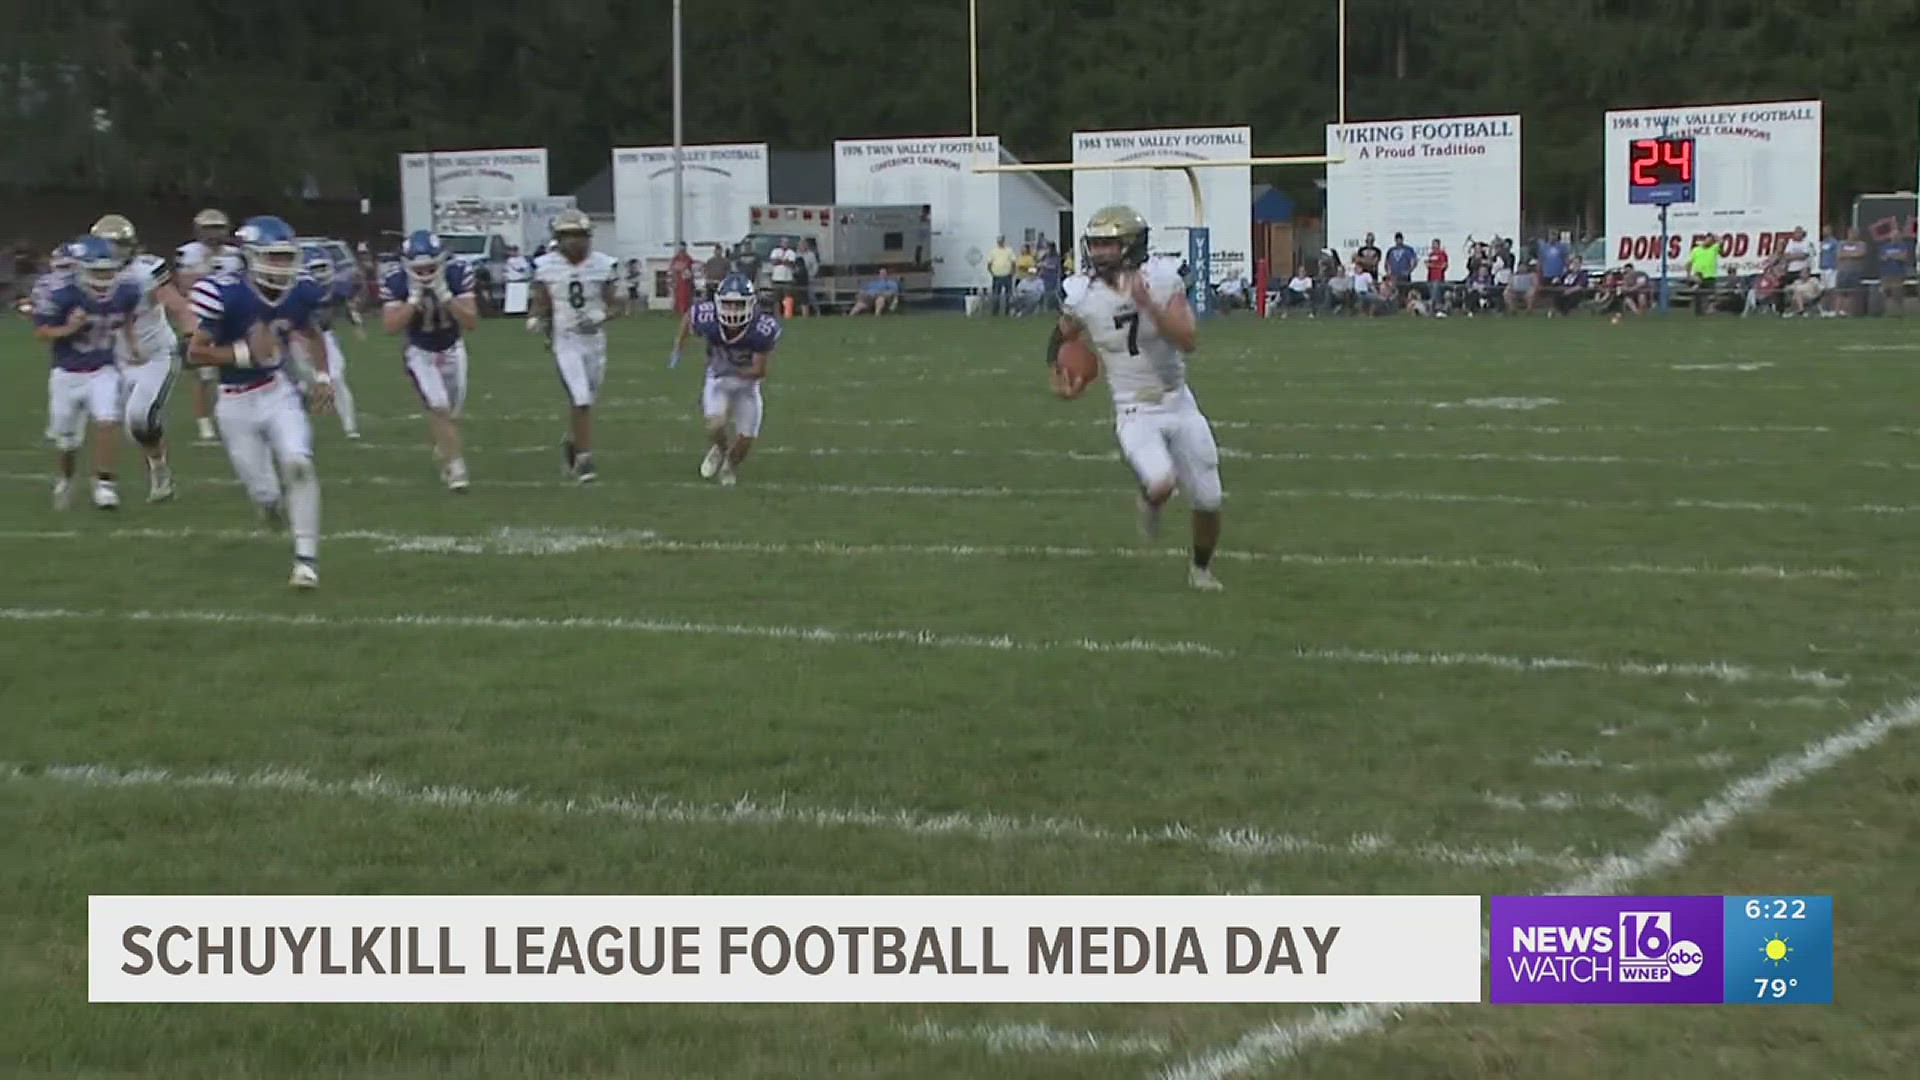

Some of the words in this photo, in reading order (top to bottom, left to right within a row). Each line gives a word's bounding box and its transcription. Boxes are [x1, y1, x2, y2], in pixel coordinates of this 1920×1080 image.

[1612, 118, 1639, 129] 1984
[1644, 115, 1680, 127] TWIN
[1685, 113, 1736, 125] VALLEY
[1741, 109, 1814, 123] FOOTBALL
[1105, 136, 1135, 149] TWIN
[1139, 135, 1181, 147] VALLEY
[1186, 133, 1245, 145] FOOTBALL
[1336, 126, 1404, 144] VIKING
[1412, 121, 1513, 140] FOOTBALL
[710, 149, 762, 161] FOOTBALL
[866, 144, 893, 155] TWIN
[896, 143, 936, 154] VALLEY
[938, 141, 995, 153] FOOTBALL
[1359, 146, 1370, 160] A
[1375, 145, 1416, 159] Proud
[1422, 142, 1487, 158] Tradition
[1633, 139, 1693, 186] 24
[1692, 232, 1749, 258] FOD
[1195, 238, 1206, 312] VIKINGS
[568, 280, 585, 309] 8
[1113, 312, 1140, 357] 7
